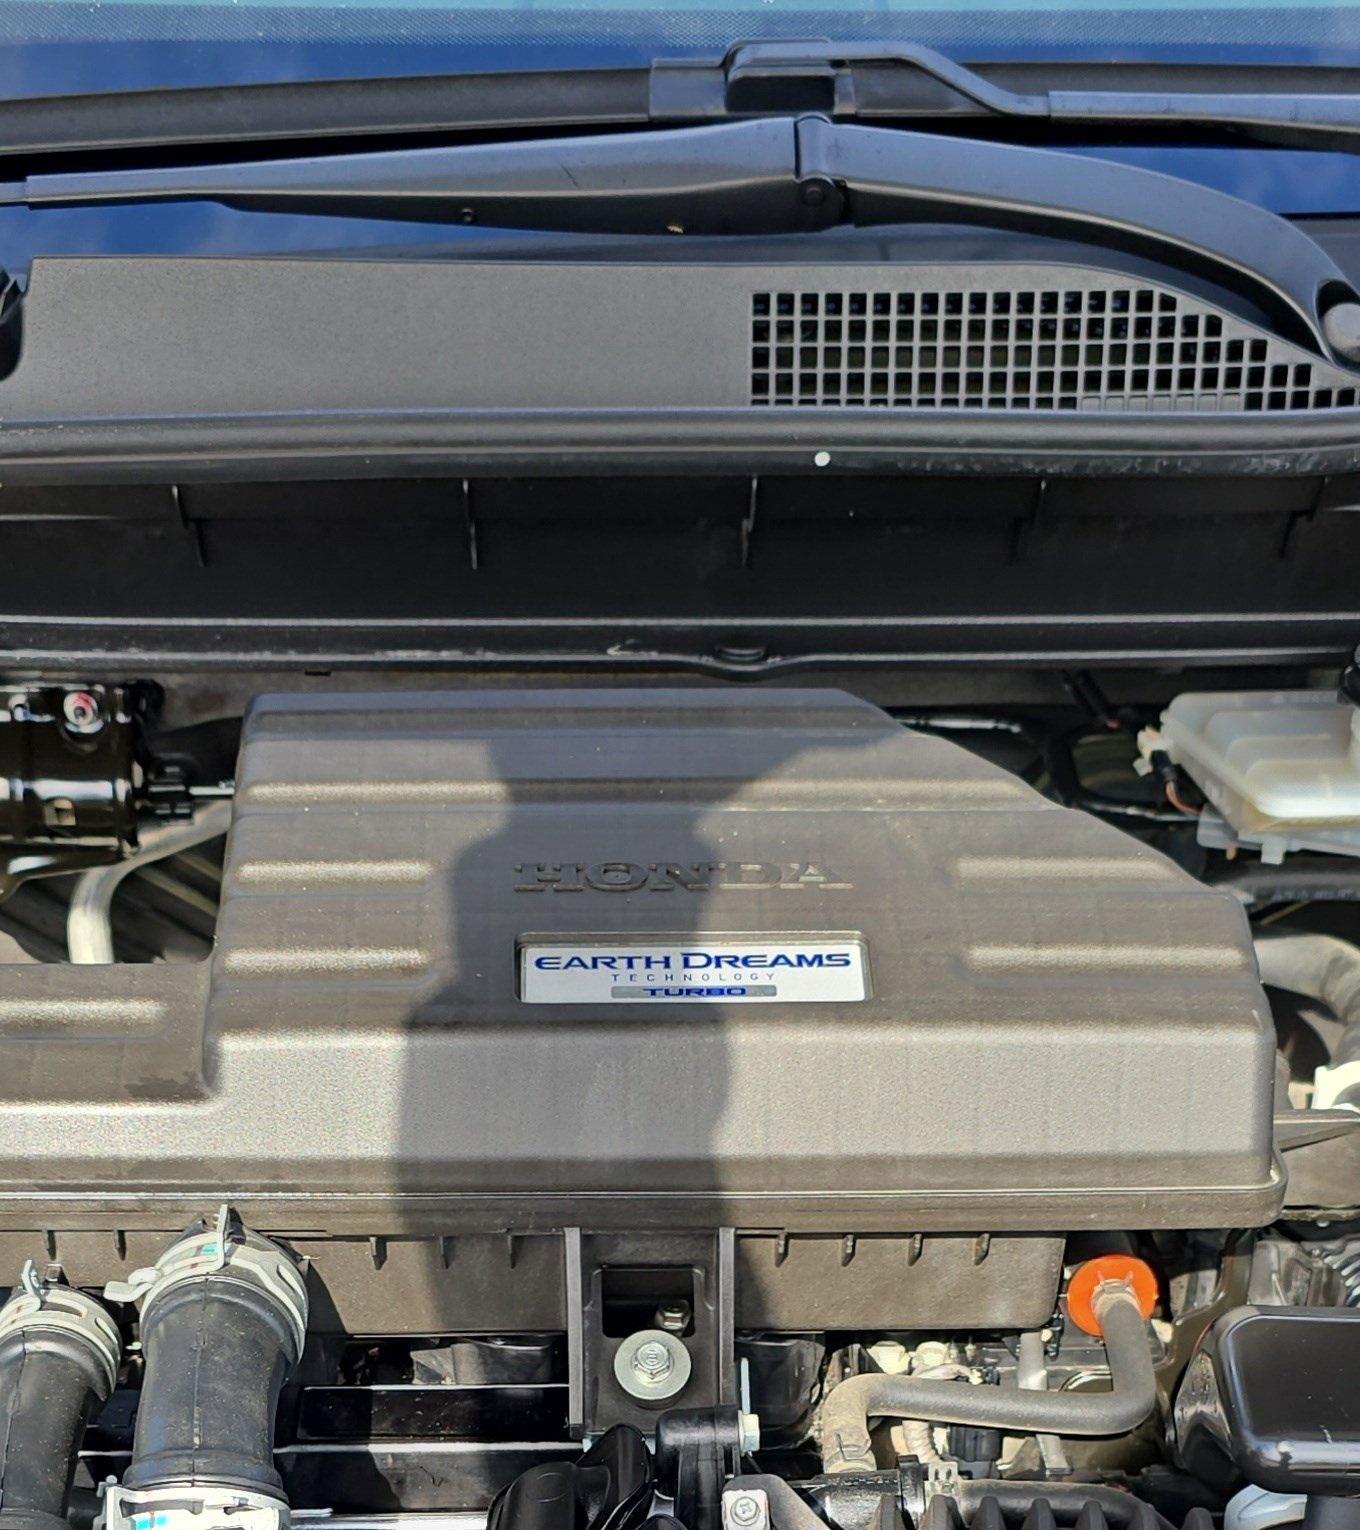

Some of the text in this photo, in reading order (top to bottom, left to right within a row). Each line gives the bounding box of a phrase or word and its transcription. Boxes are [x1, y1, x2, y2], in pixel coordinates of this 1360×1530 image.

[513, 861, 854, 893] HONDA
[534, 952, 852, 971] EARTH DREAMS
[611, 972, 777, 983] TECHNOLOGY
[641, 986, 748, 997] TURBO
